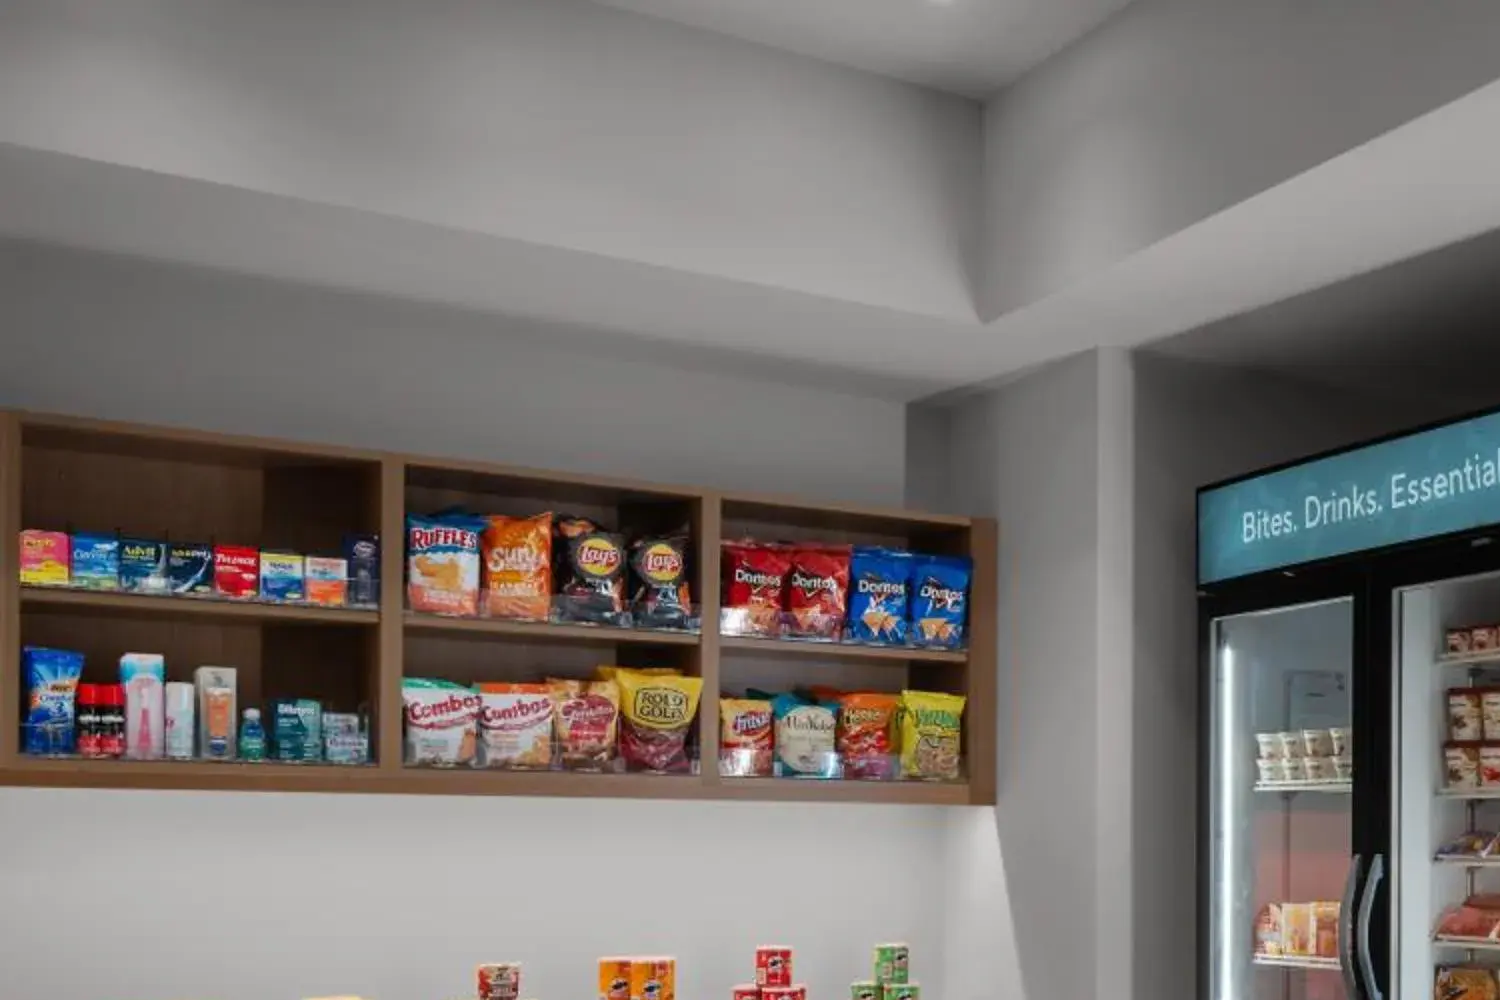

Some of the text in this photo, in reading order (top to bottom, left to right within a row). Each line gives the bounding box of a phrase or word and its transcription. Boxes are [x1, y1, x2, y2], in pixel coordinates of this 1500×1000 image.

[1242, 508, 1297, 544] Bites.
[1304, 485, 1383, 529] Drinks.
[411, 527, 477, 549] RUFFLES
[735, 569, 781, 587] Doritos
[792, 574, 838, 590] Doritos
[858, 579, 905, 595] Doritos
[921, 585, 964, 601] Doritos
[408, 694, 483, 722] Combos
[481, 696, 550, 723] Combos
